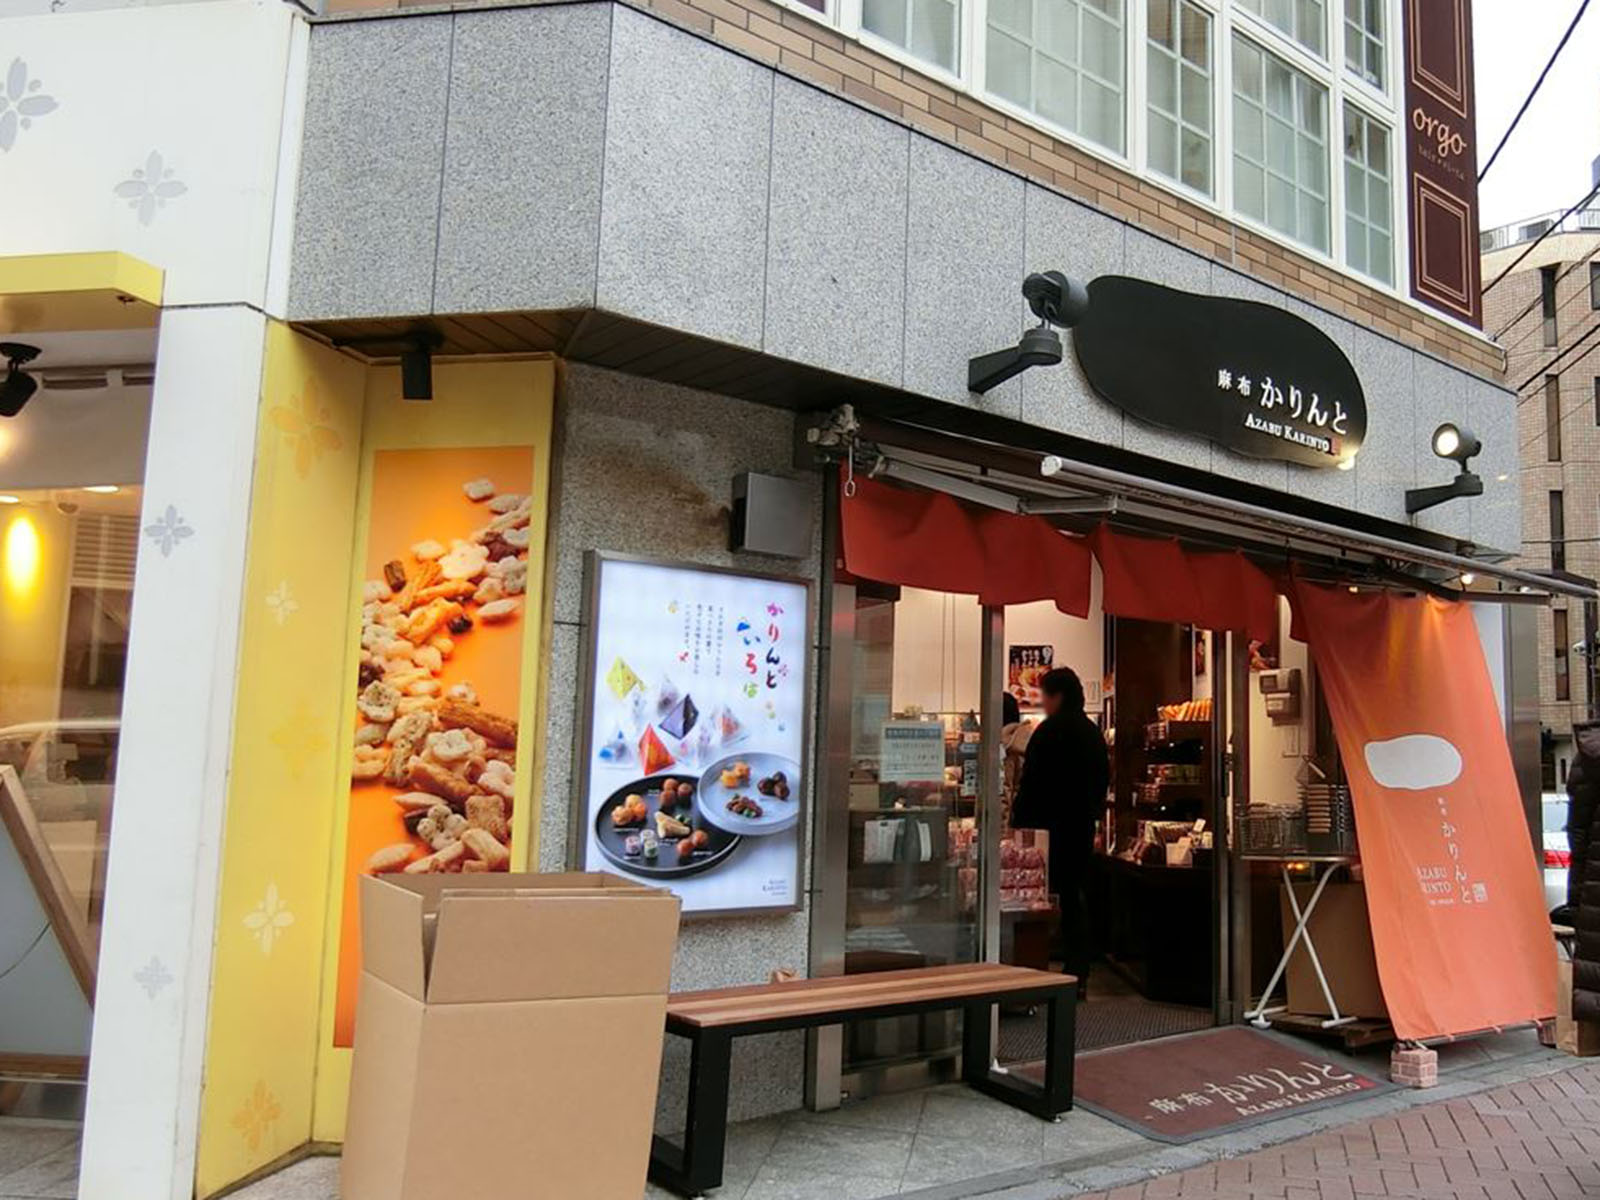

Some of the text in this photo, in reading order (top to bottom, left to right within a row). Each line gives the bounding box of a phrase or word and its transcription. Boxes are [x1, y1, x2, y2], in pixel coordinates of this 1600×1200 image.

[1413, 108, 1467, 158] orgo
[1217, 369, 1347, 435] 麻布 かりんと
[1244, 413, 1330, 452] AZABU KARINTO
[1204, 1061, 1353, 1103] かりんと
